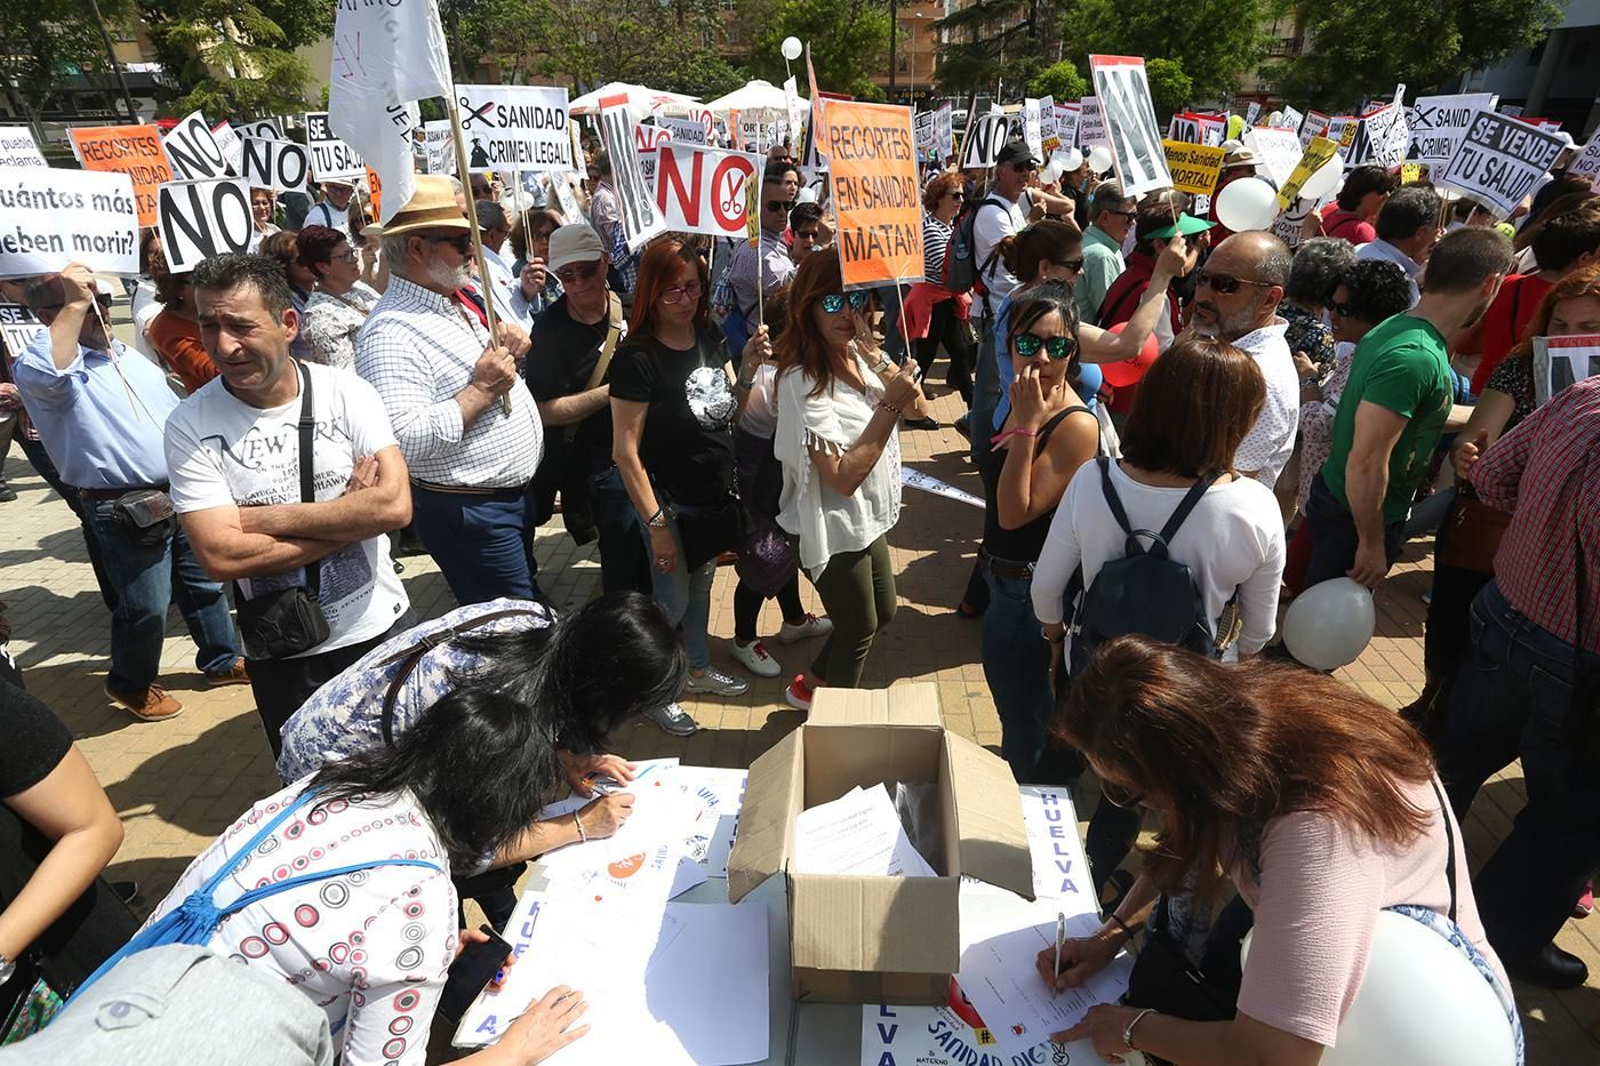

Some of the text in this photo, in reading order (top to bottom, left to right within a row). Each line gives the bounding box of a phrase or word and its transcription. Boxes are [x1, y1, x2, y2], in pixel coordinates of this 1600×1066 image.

[310, 119, 326, 140] SE
[497, 106, 569, 136] SANIDAD,
[80, 136, 160, 162] RECORTES
[165, 118, 224, 179] NO
[489, 139, 570, 165] CRIMEN LEGAL!
[830, 126, 912, 161] RECORTES
[966, 117, 1008, 163] NO
[1471, 117, 1560, 170] SE VENDE
[242, 138, 307, 189] NO
[313, 146, 367, 172] TU SALU
[1188, 150, 1220, 169] Sanidad
[1454, 146, 1537, 203] TU SALUD
[92, 189, 134, 214] más
[657, 147, 757, 232] NO
[836, 175, 916, 211] EN SANIDAD
[0, 226, 135, 255] eben morir?
[160, 181, 252, 266] NO
[1, 308, 25, 324] SE
[200, 426, 287, 470] NEW
[1041, 793, 1080, 894] HUELVA
